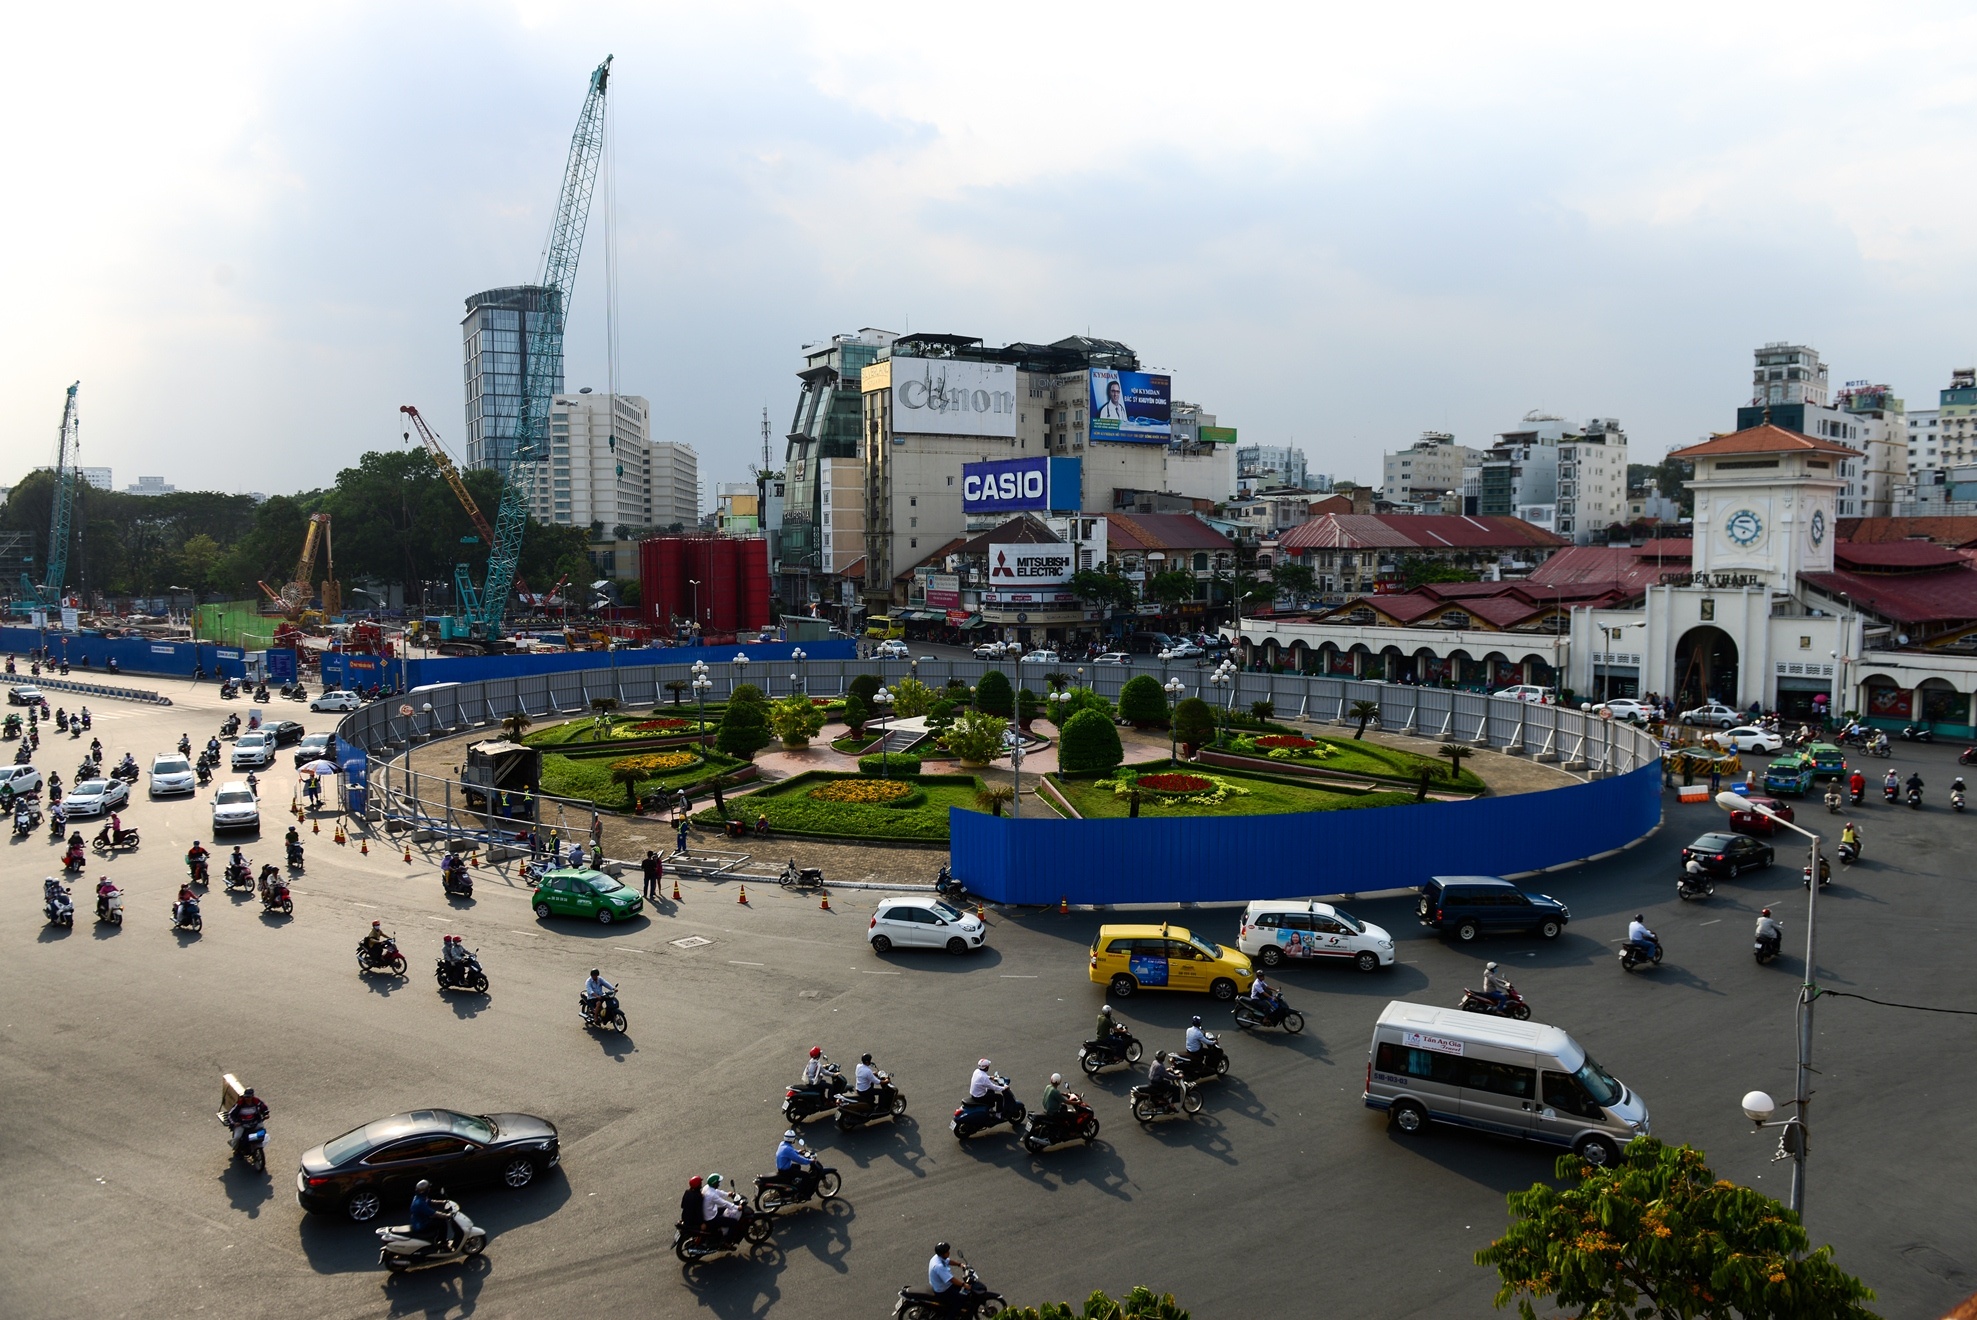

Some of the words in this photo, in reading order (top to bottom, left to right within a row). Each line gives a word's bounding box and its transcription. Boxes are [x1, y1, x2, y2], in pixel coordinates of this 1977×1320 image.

[1092, 371, 1118, 380] KYMDAN
[899, 380, 1014, 414] Canon
[1139, 388, 1161, 396] KYMDAN
[963, 470, 1044, 501] CASIO
[1016, 556, 1070, 567] MITSUBISHI
[1016, 566, 1064, 577] ELECTRIC
[1714, 571, 1758, 585] THÀNH
[1437, 1038, 1448, 1046] An
[1448, 1040, 1462, 1048] Gia
